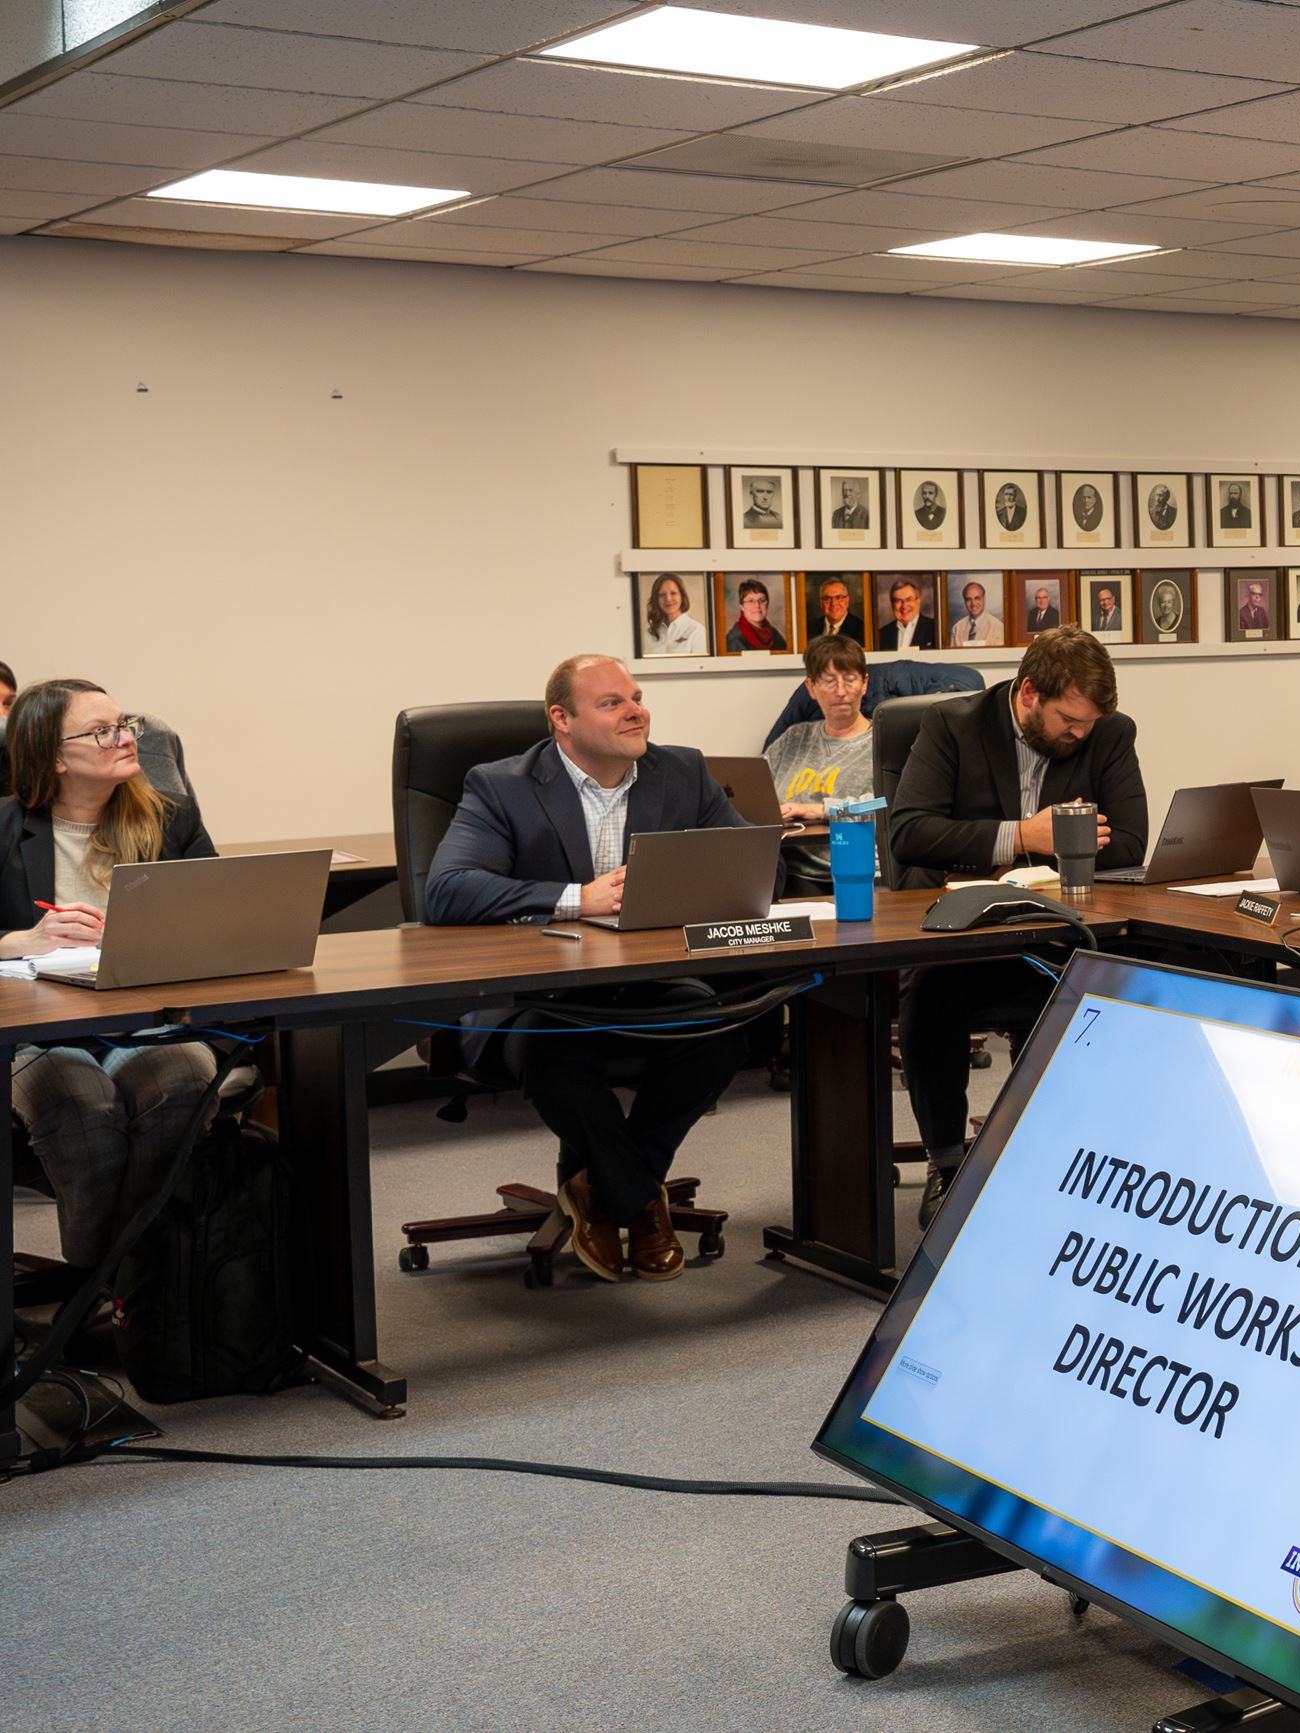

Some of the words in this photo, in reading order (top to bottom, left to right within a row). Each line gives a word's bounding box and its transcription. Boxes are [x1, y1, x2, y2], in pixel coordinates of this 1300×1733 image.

[1239, 898, 1255, 911] JACKIE
[1253, 902, 1274, 917] RAFFETY
[707, 925, 744, 939] JACOB
[745, 921, 792, 936] MESHKE
[728, 937, 744, 946] CITY
[744, 935, 775, 944] MANAGER
[1074, 1008, 1101, 1047] 7.
[1049, 1230, 1181, 1314] PUBLIC
[1052, 1323, 1240, 1440] DIRECTOR
